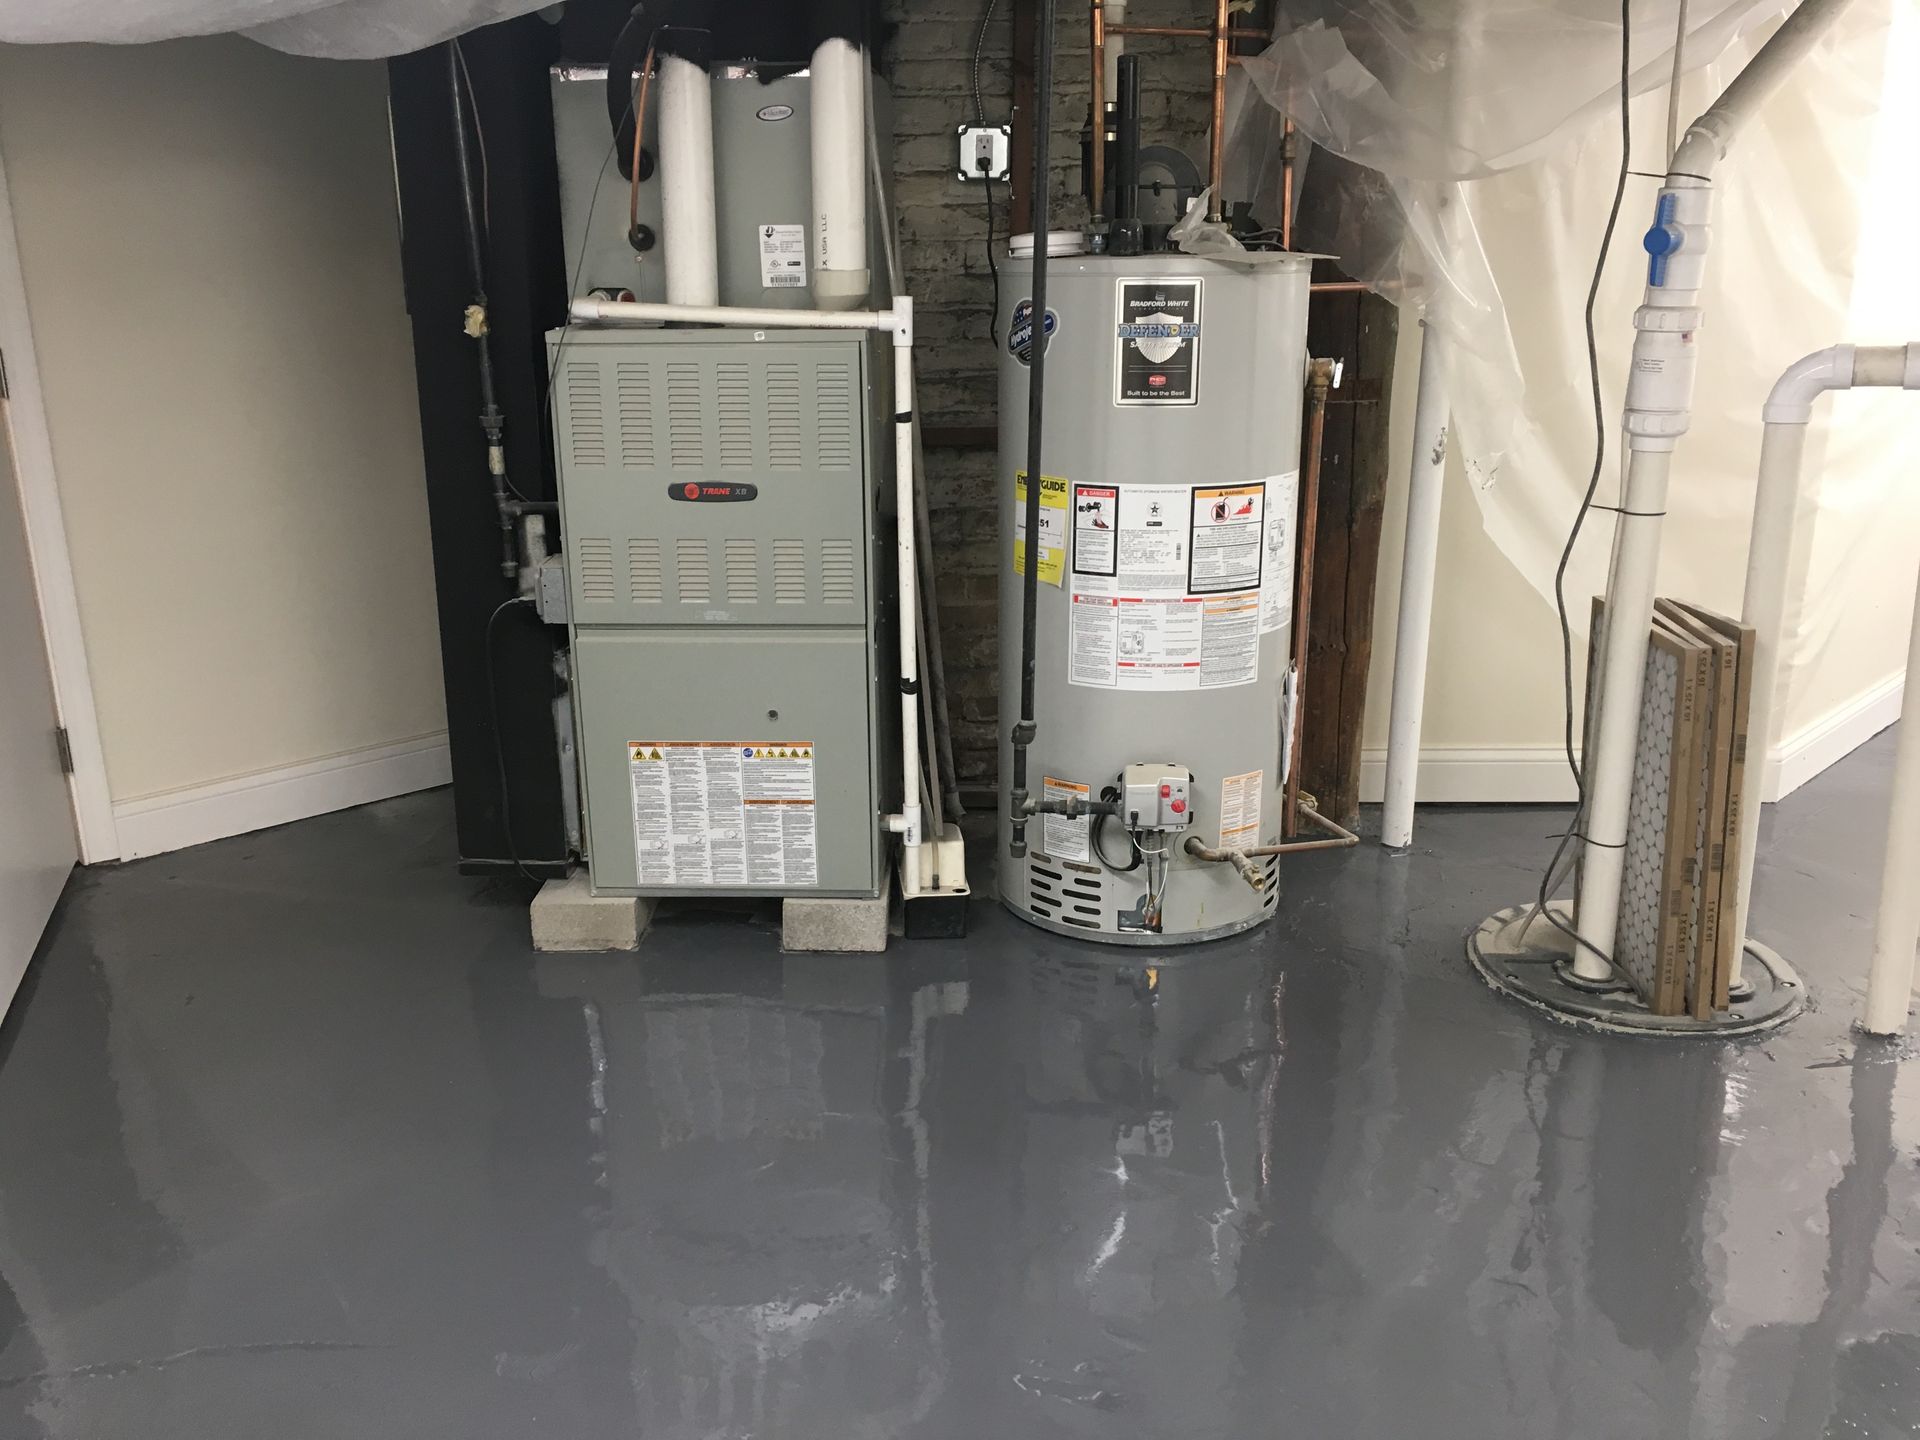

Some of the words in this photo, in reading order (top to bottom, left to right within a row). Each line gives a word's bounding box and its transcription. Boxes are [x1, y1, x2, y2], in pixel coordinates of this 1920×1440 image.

[1119, 323, 1200, 338] DEFENDER
[703, 487, 731, 495] TRANE
[1700, 658, 1707, 668] 25
[1724, 660, 1732, 668] 16
[1698, 677, 1705, 686] 16
[1684, 712, 1691, 721] 16
[1707, 914, 1713, 924] 25
[1706, 933, 1713, 942] 16
[1679, 945, 1685, 953] 16
